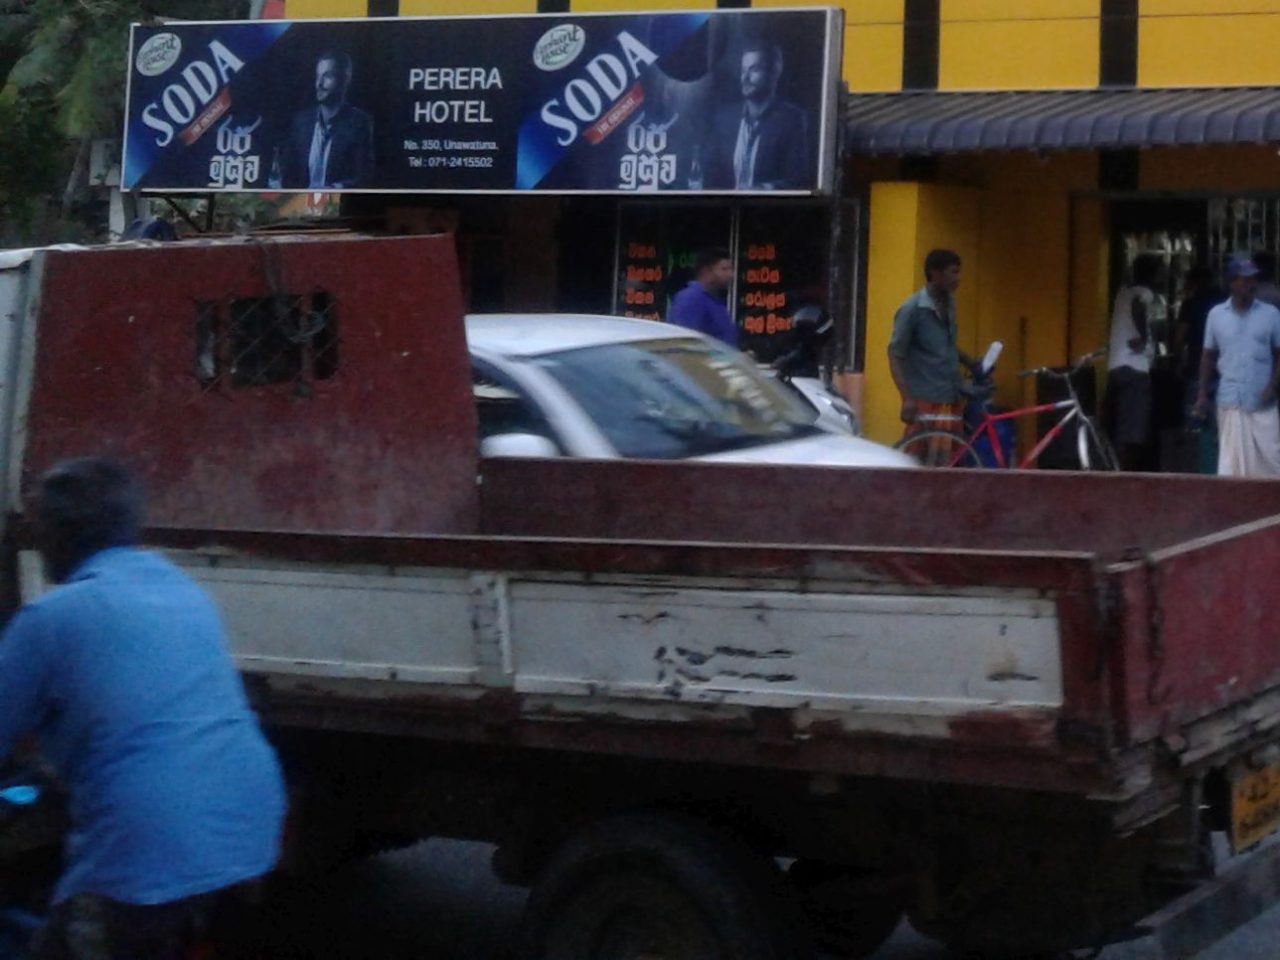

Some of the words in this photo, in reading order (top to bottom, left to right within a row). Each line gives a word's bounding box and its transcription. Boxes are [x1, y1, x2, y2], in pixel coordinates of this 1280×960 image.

[142, 39, 245, 147] SODA
[408, 66, 503, 90] PERERA
[540, 30, 659, 147] SODA
[414, 100, 493, 123] HOTEL
